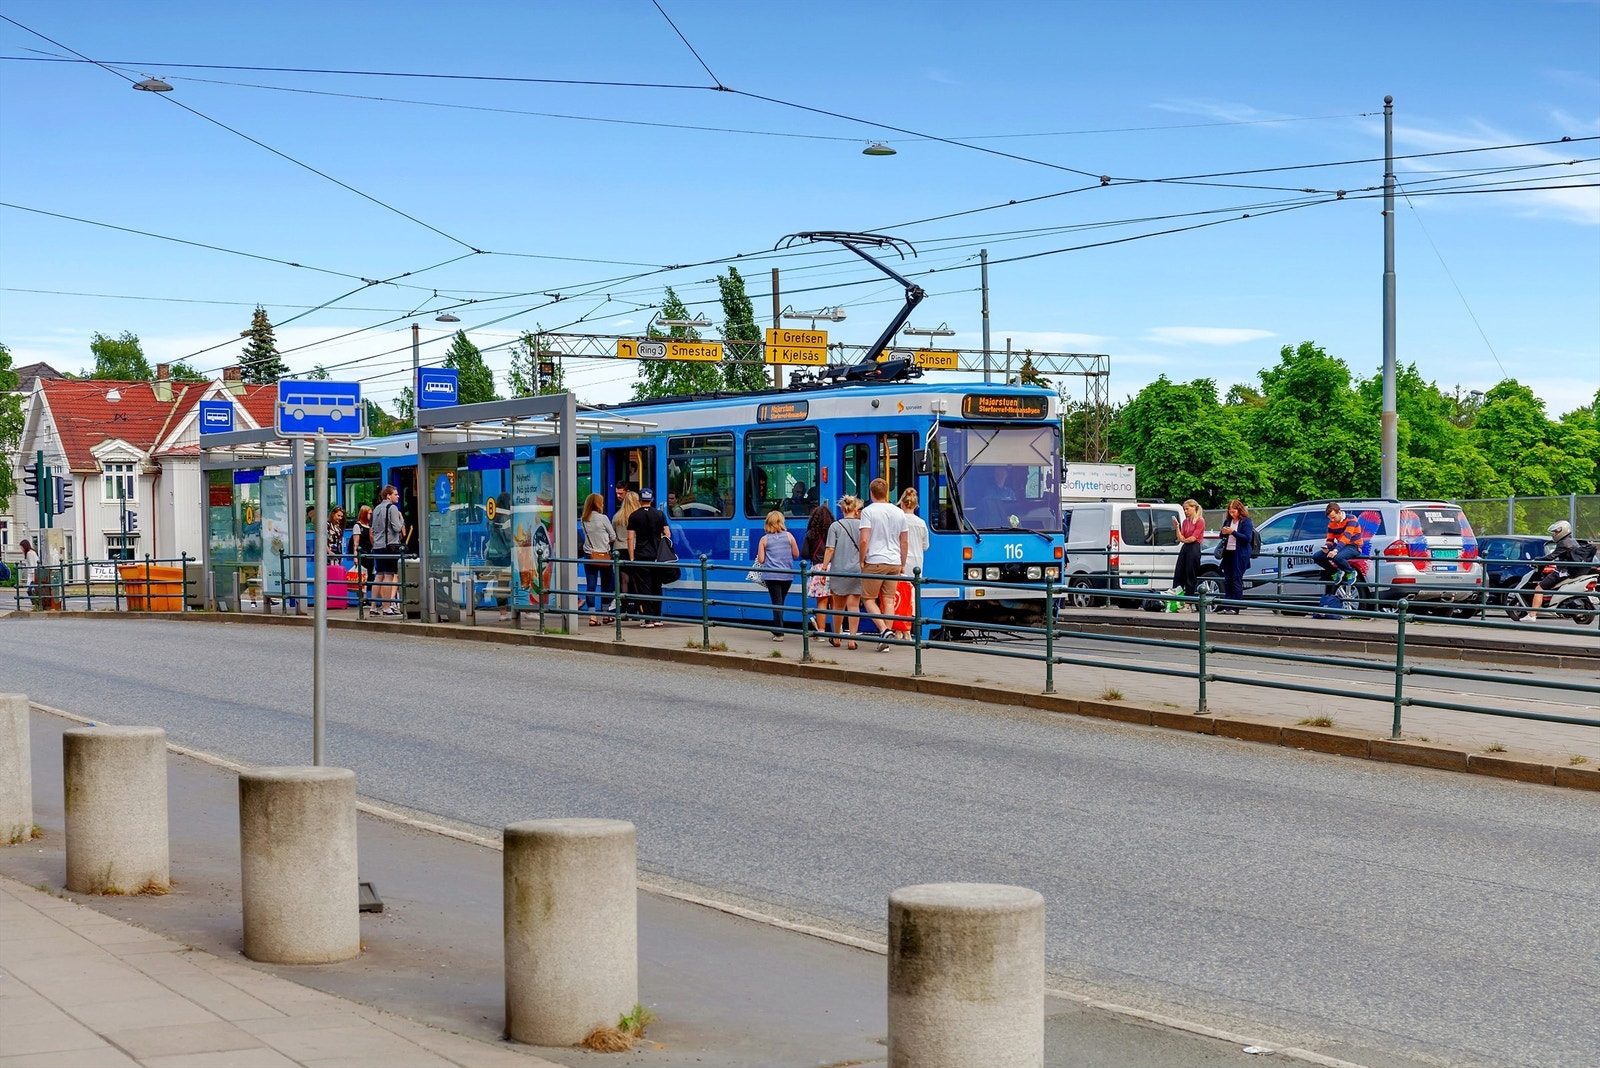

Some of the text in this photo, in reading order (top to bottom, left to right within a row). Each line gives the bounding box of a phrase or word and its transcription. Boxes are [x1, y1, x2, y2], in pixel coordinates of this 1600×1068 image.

[784, 332, 823, 344] Grefsen
[640, 346, 664, 355] Ring 3
[672, 344, 718, 356] Smestad
[782, 350, 819, 362] Kjelsås
[920, 354, 952, 364] Sinsen
[980, 398, 1018, 406] Majorstuen
[1004, 544, 1024, 559] 116
